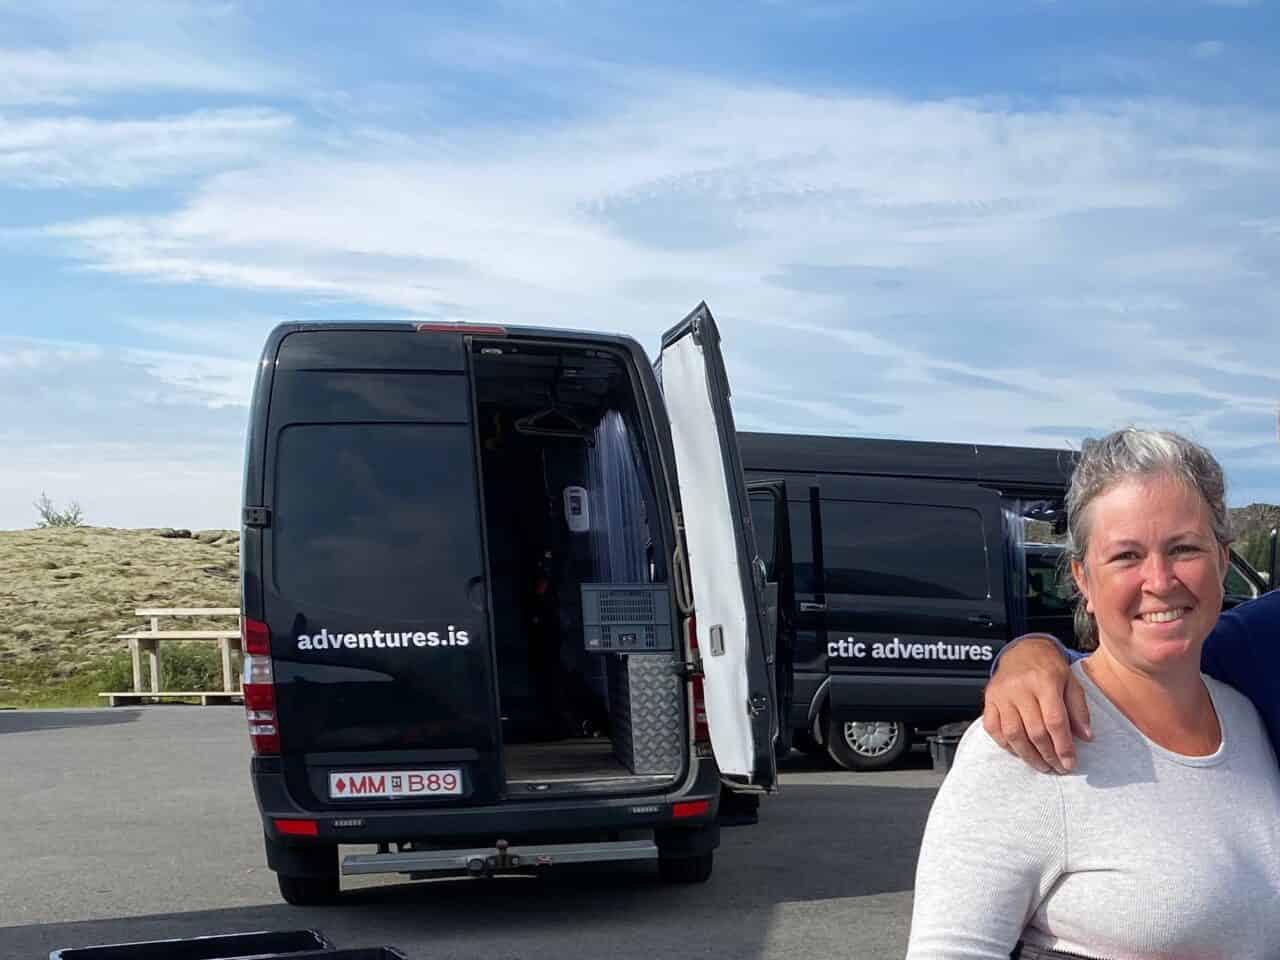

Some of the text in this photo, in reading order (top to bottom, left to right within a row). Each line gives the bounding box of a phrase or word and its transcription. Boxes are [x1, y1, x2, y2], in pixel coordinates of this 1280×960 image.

[297, 626, 470, 650] adventures.is
[871, 637, 993, 661] adventures
[349, 773, 457, 794] MM B89
